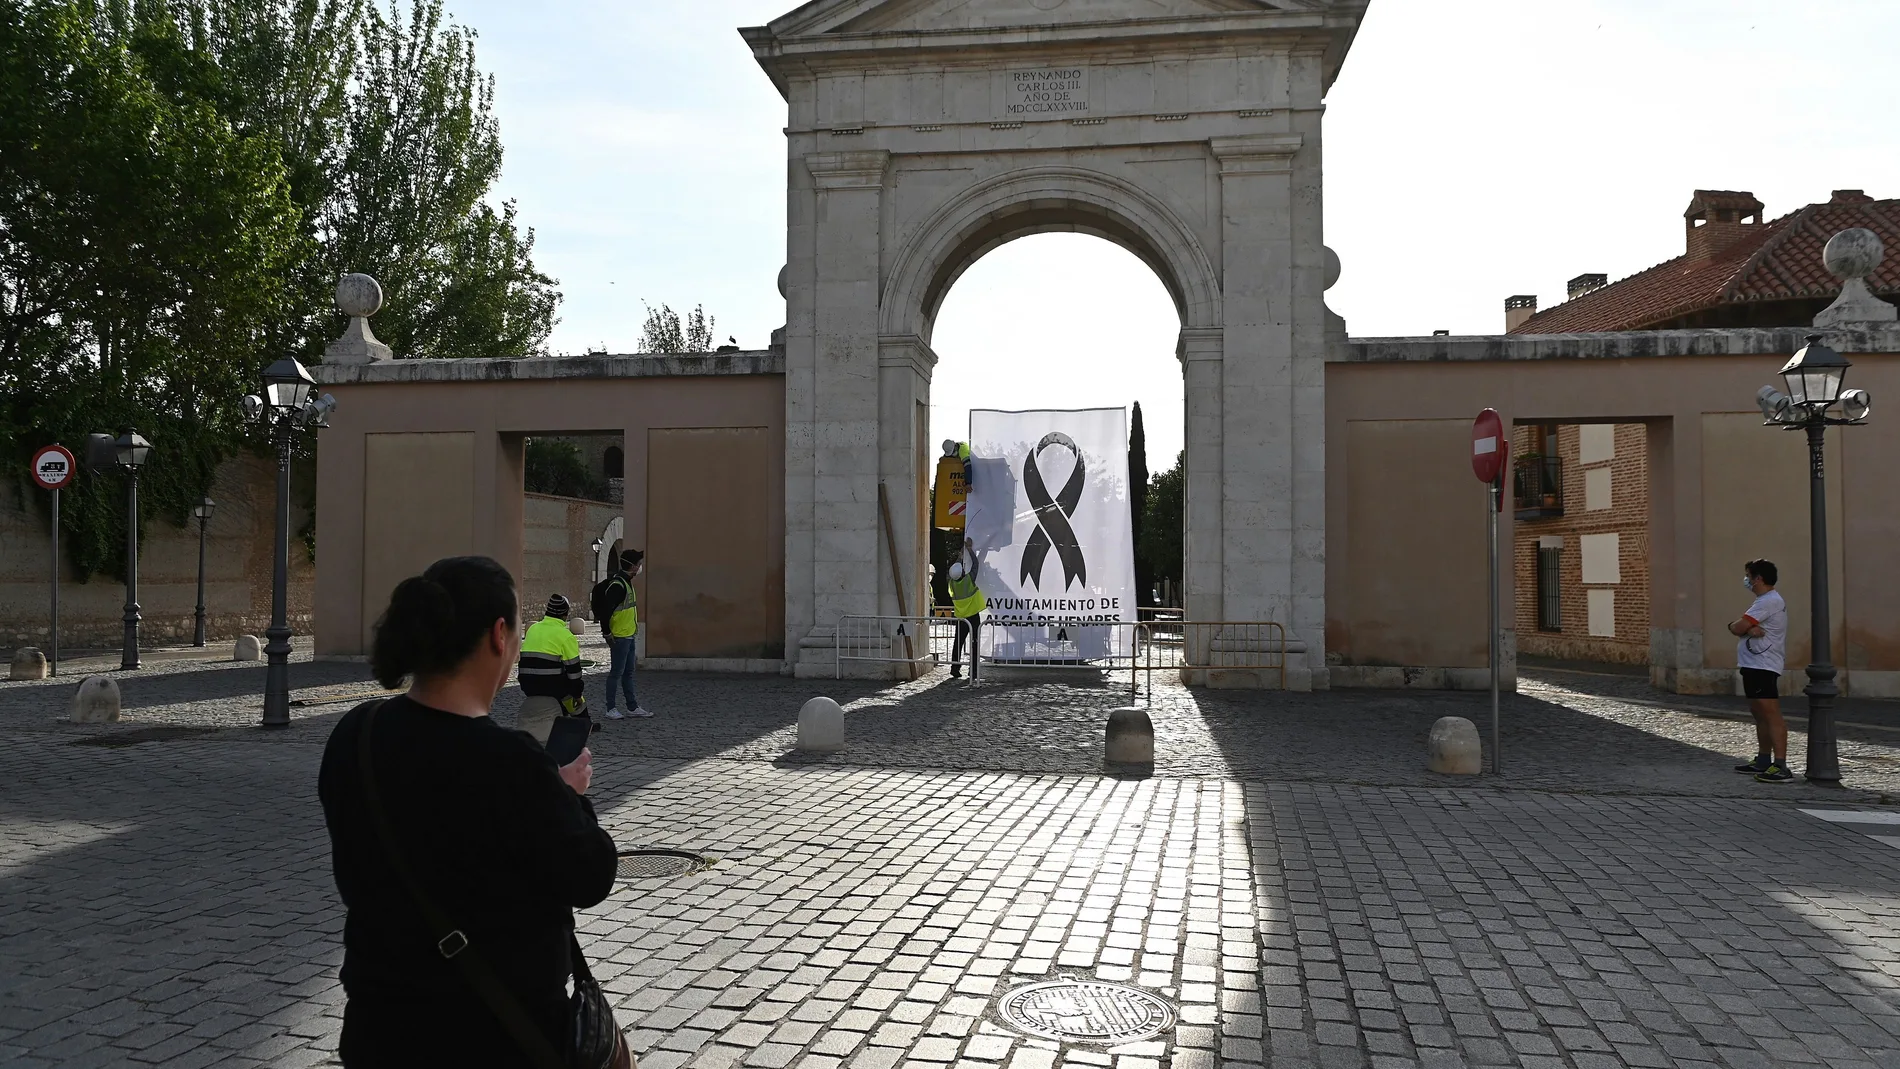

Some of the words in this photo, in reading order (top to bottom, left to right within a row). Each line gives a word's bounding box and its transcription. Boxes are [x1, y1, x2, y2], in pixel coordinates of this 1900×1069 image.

[1013, 70, 1081, 81] REYNANDO
[1017, 81, 1065, 92] CARLOS
[1024, 91, 1050, 102] AÑO
[1054, 91, 1071, 101] DE
[986, 598, 1095, 611] AYUNTAMIENTO
[1101, 597, 1119, 609] DE
[985, 612, 1034, 627] ALCALÁ
[1038, 615, 1054, 627] DE
[1058, 614, 1120, 627] HENARES
